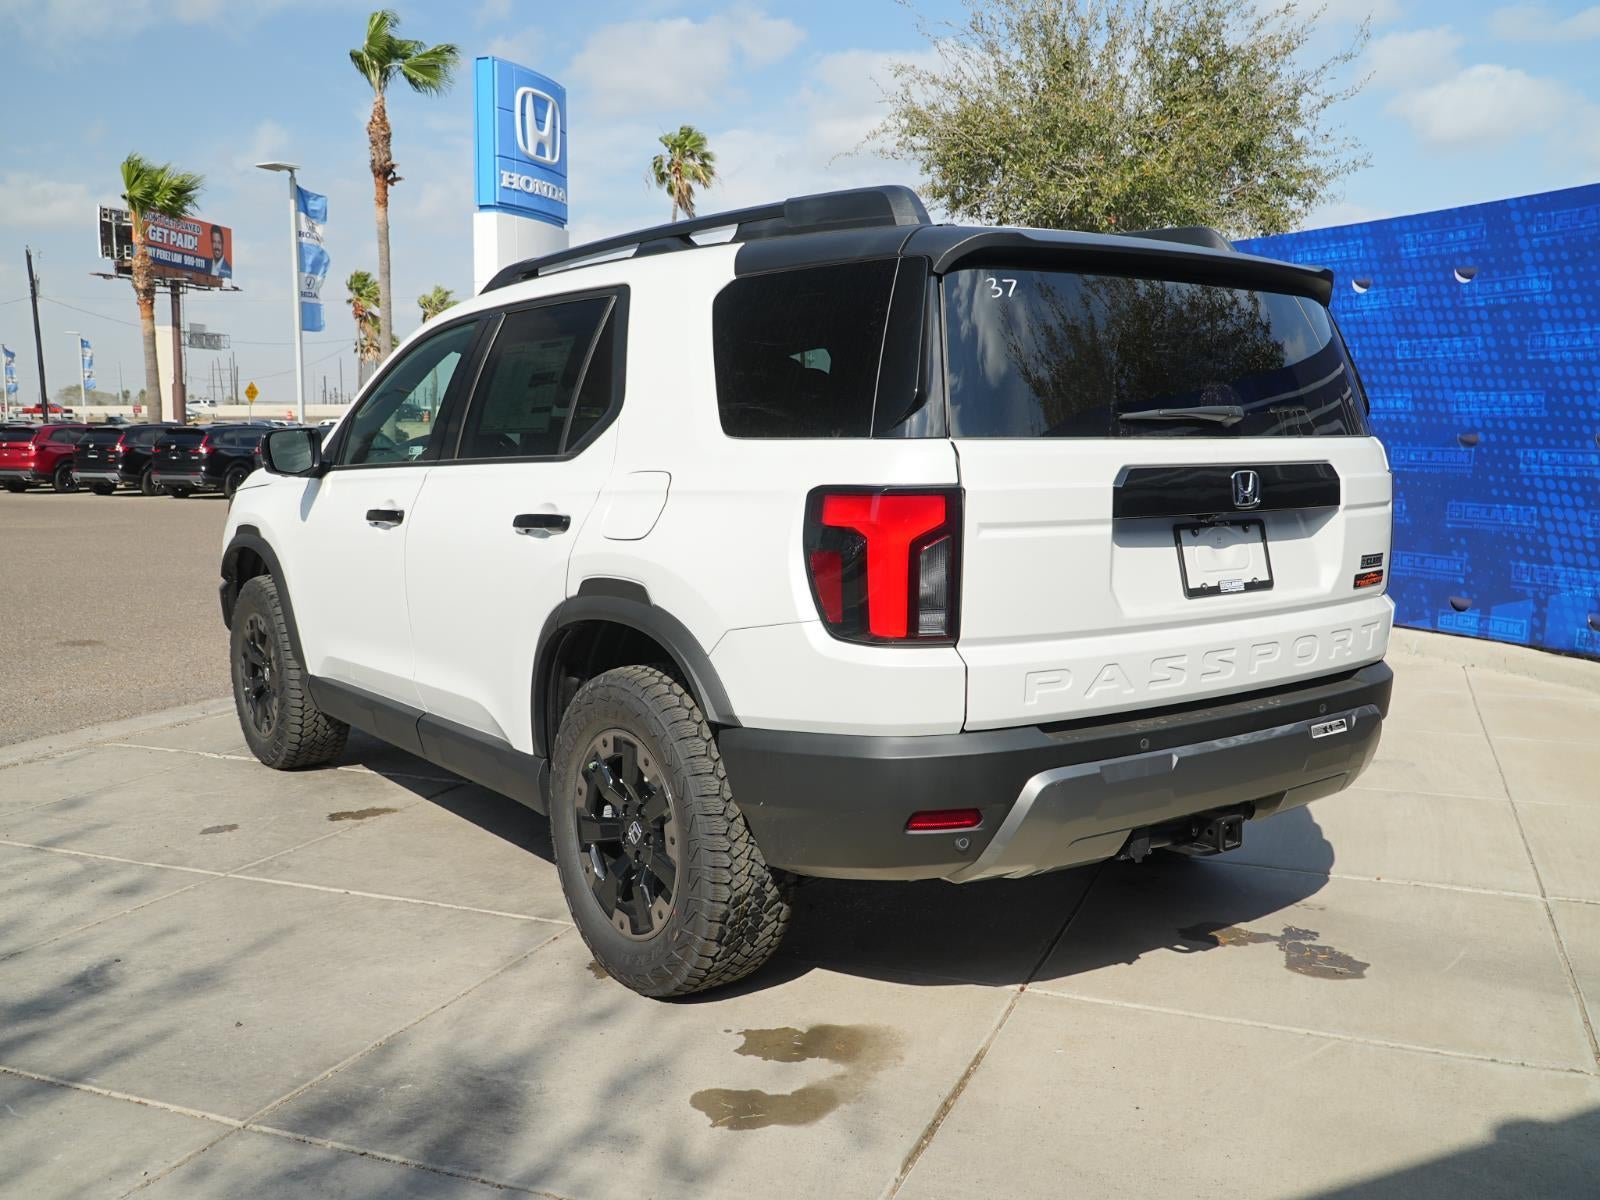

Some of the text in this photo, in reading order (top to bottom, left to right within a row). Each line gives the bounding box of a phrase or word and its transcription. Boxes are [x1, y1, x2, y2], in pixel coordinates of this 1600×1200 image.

[500, 169, 568, 206] HONDA
[176, 219, 201, 234] PLAYED
[148, 225, 198, 251] GET PAID!
[156, 248, 171, 262] PEREZ
[985, 277, 1018, 298] 37
[1466, 506, 1533, 523] CLARK
[1402, 555, 1462, 571] CLARK
[1023, 620, 1382, 706] PASSPORT
